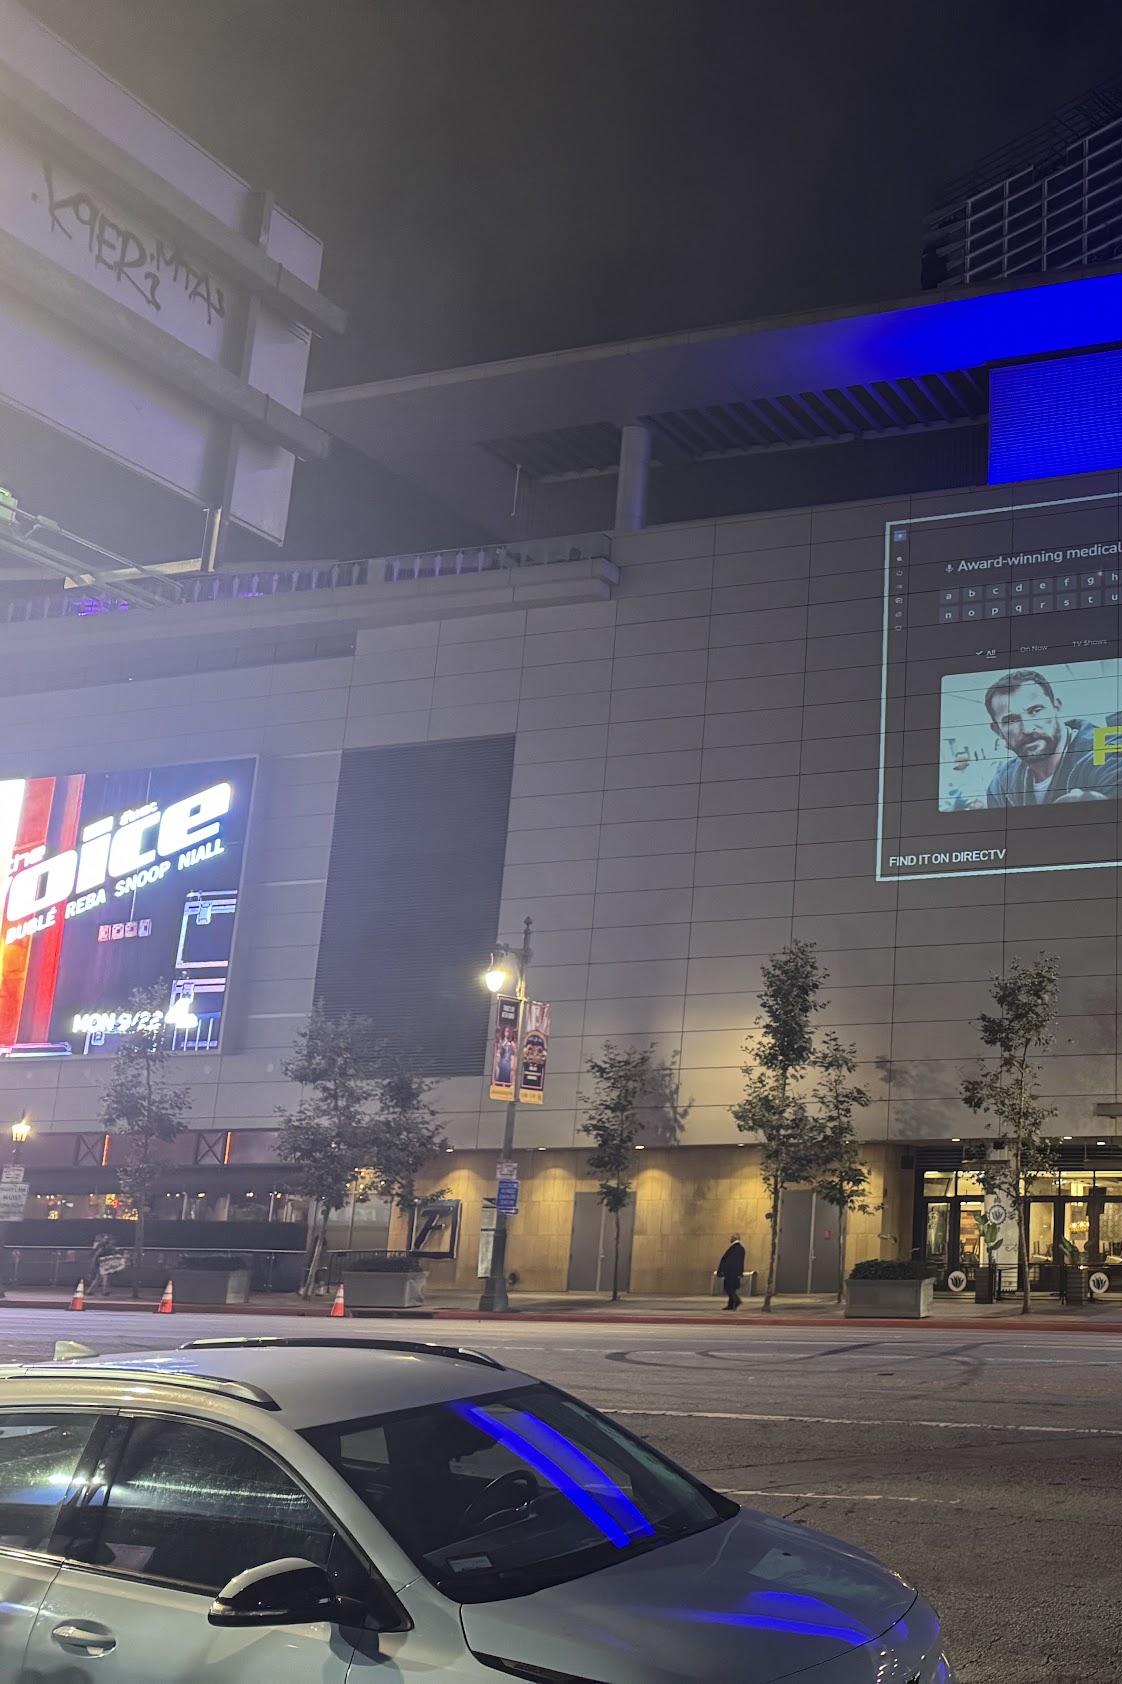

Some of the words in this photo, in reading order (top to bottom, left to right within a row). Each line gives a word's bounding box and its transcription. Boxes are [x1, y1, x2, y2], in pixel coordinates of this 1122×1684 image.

[957, 551, 1063, 572] Award-winning
[1066, 541, 1122, 559] medical
[1083, 638, 1107, 646] Shows
[889, 855, 917, 867] FIND
[918, 854, 930, 865] IT
[932, 852, 950, 864] ON
[952, 848, 1006, 863] DIRECTV
[65, 888, 106, 920] REBA
[114, 860, 171, 897] SNOOP
[177, 838, 225, 871] NIALL
[72, 1011, 115, 1033] MON
